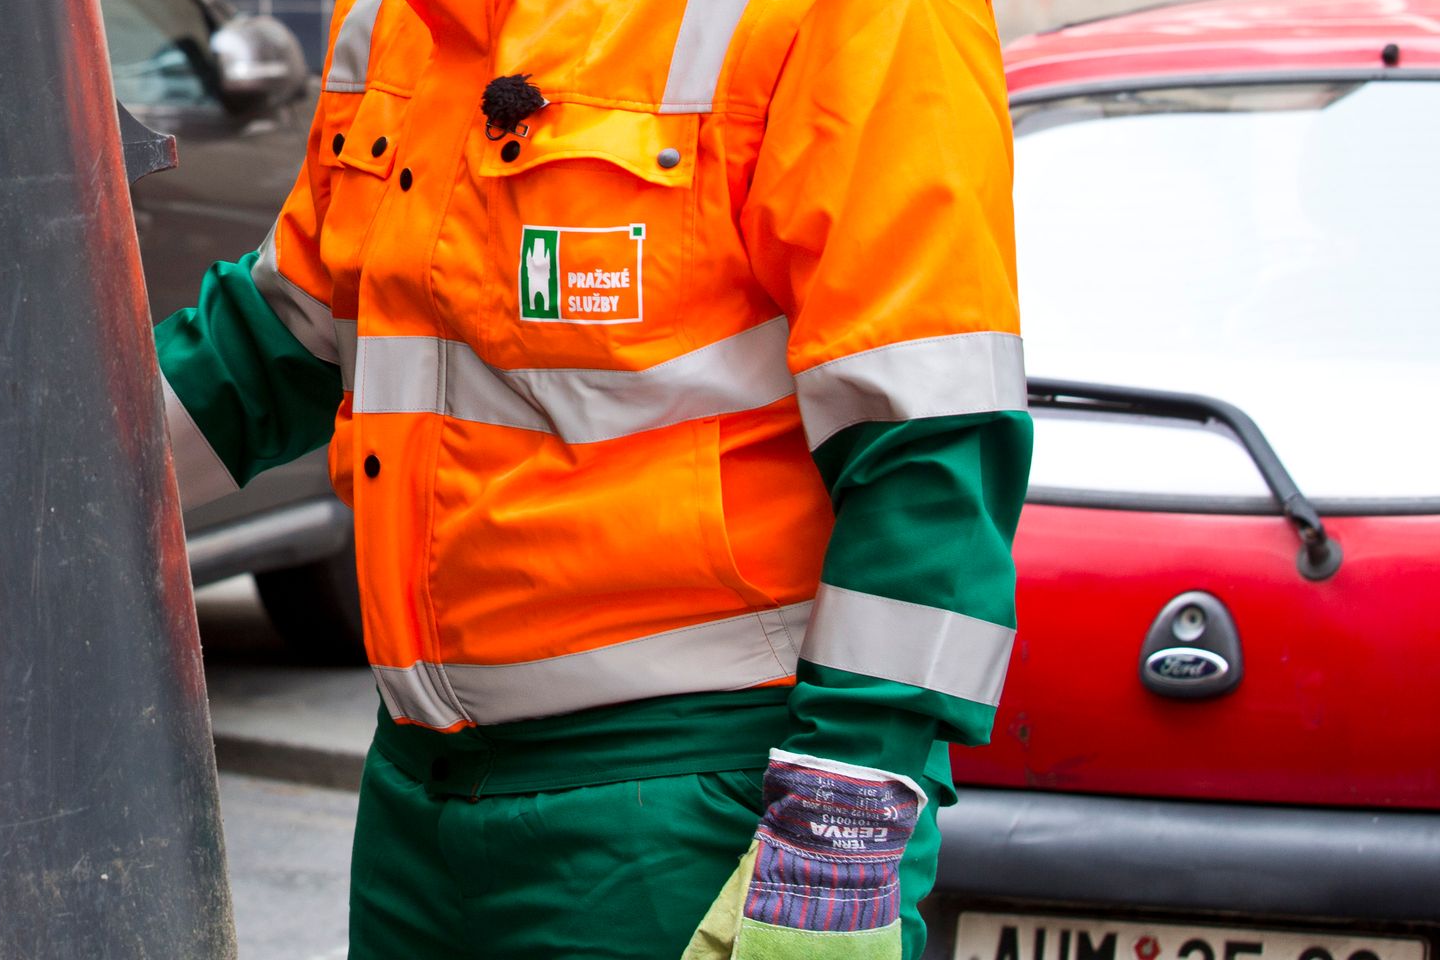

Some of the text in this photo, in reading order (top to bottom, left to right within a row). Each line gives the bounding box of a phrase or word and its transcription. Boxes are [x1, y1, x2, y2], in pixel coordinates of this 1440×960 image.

[567, 268, 631, 289] PRAŽSKÉ
[567, 292, 620, 313] SLUŽBY
[832, 839, 866, 849] TERN
